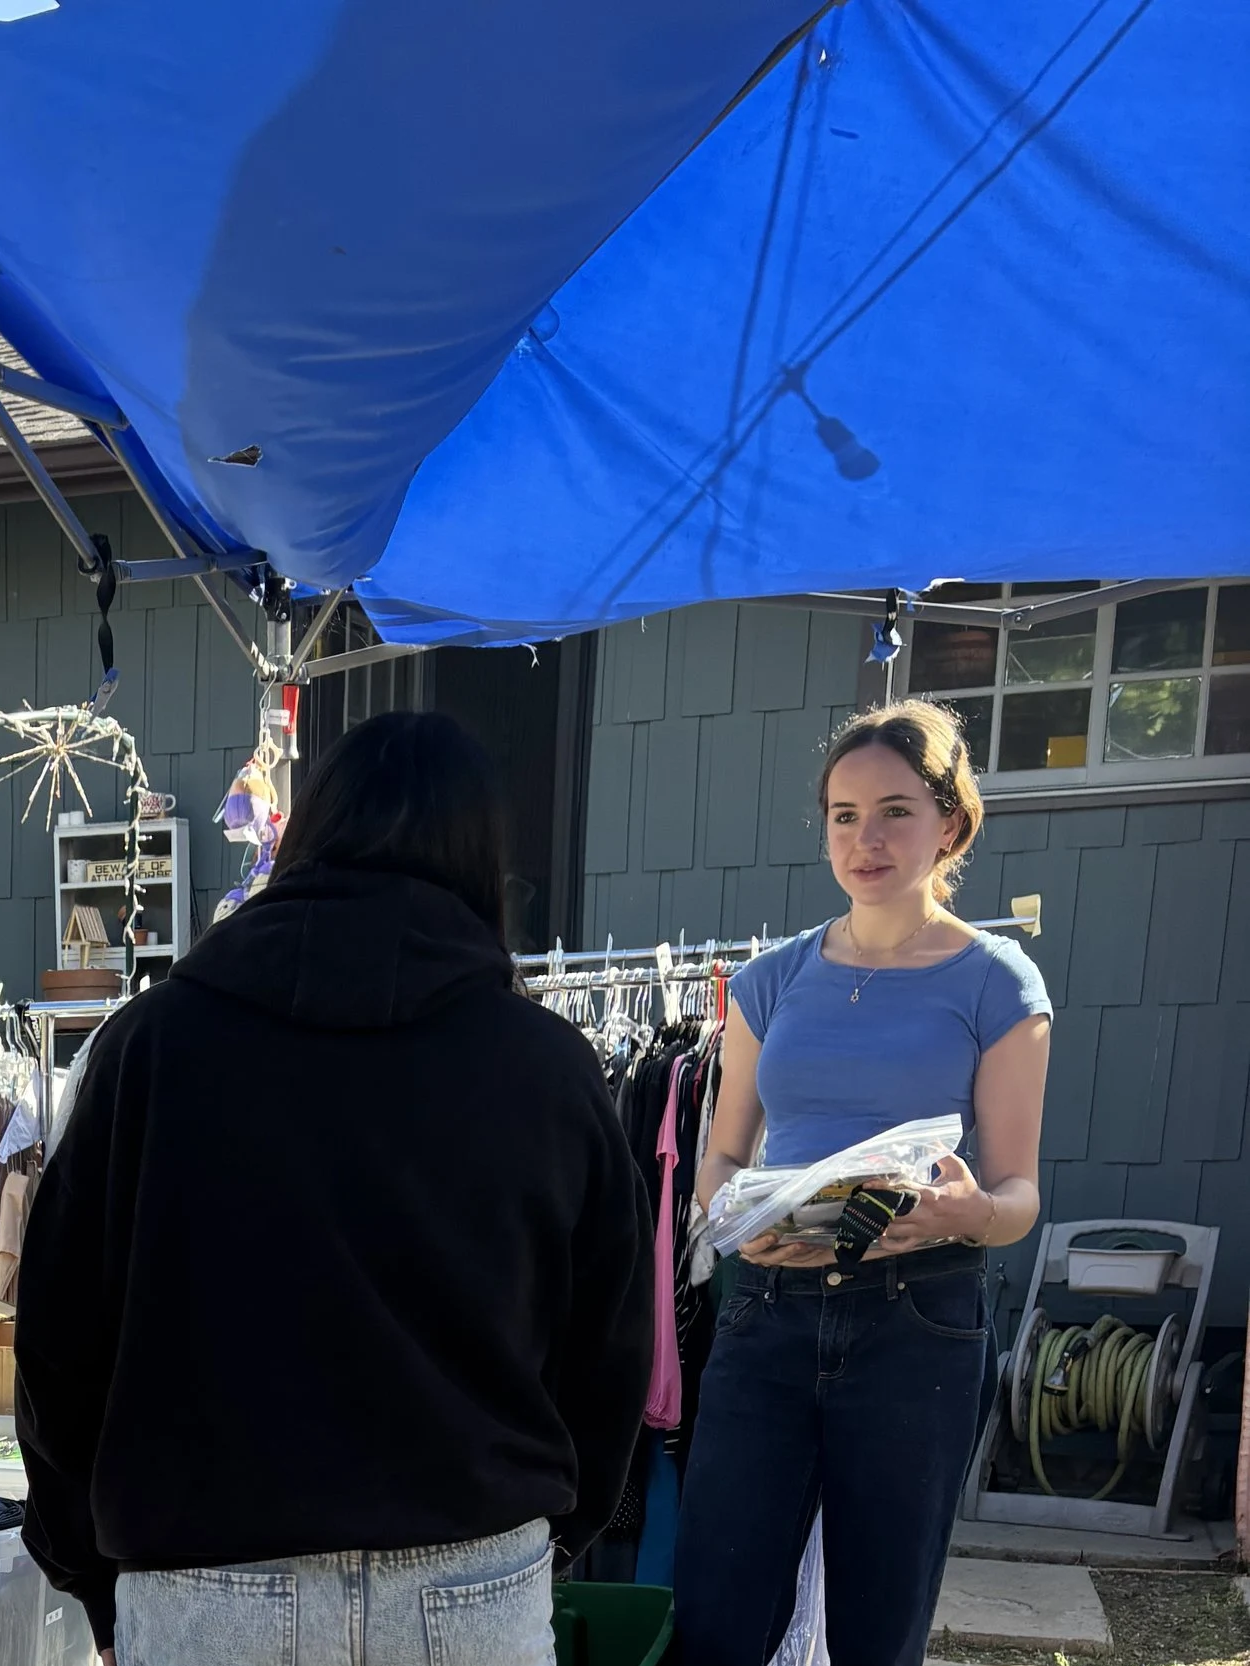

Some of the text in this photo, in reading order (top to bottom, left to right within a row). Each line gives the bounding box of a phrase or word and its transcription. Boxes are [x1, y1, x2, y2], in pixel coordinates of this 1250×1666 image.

[95, 861, 166, 874] BEWE OF
[91, 873, 125, 881] ATTAC
